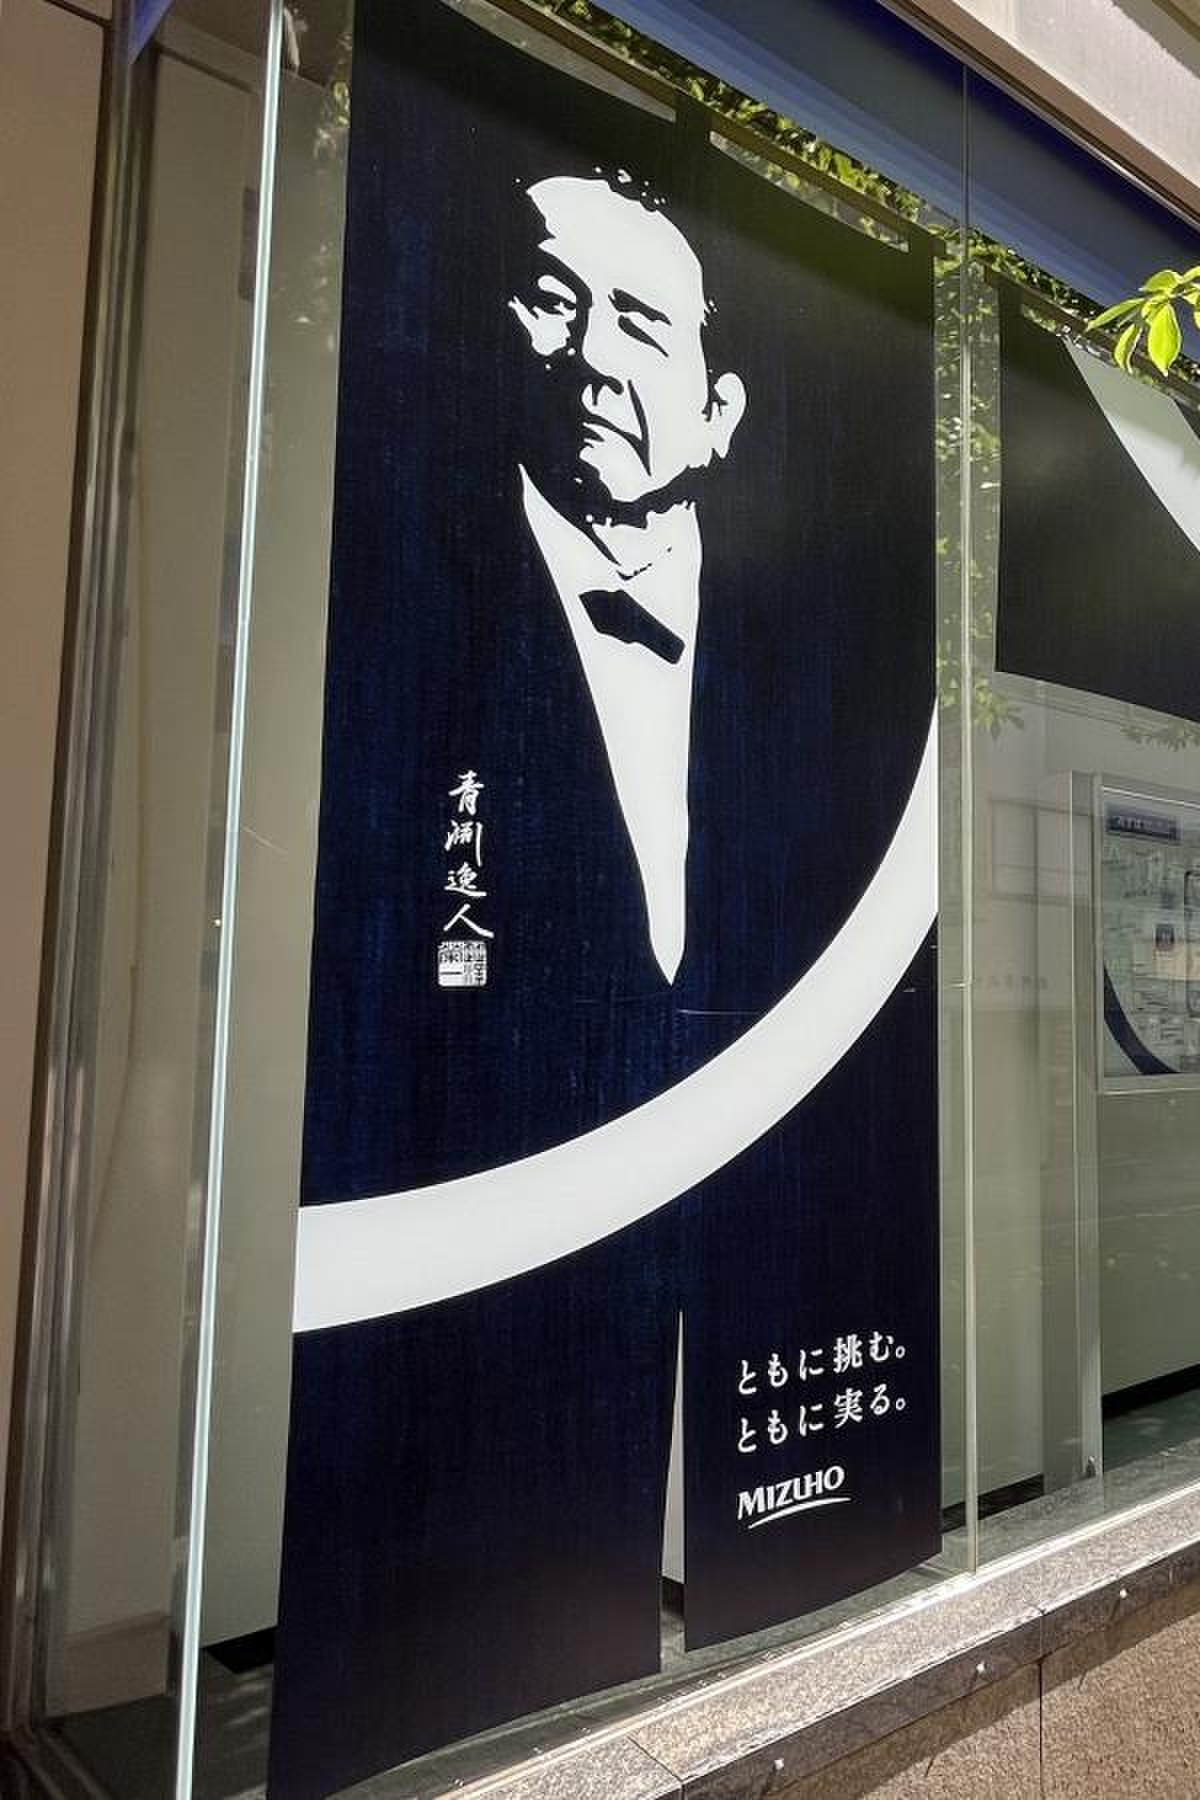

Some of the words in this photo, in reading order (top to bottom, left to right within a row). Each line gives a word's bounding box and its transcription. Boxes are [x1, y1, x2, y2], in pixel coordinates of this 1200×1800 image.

[738, 1331, 906, 1395] ともに挑む。
[738, 1383, 906, 1453] ともに実る。
[737, 1465, 846, 1520] MIZUHO
